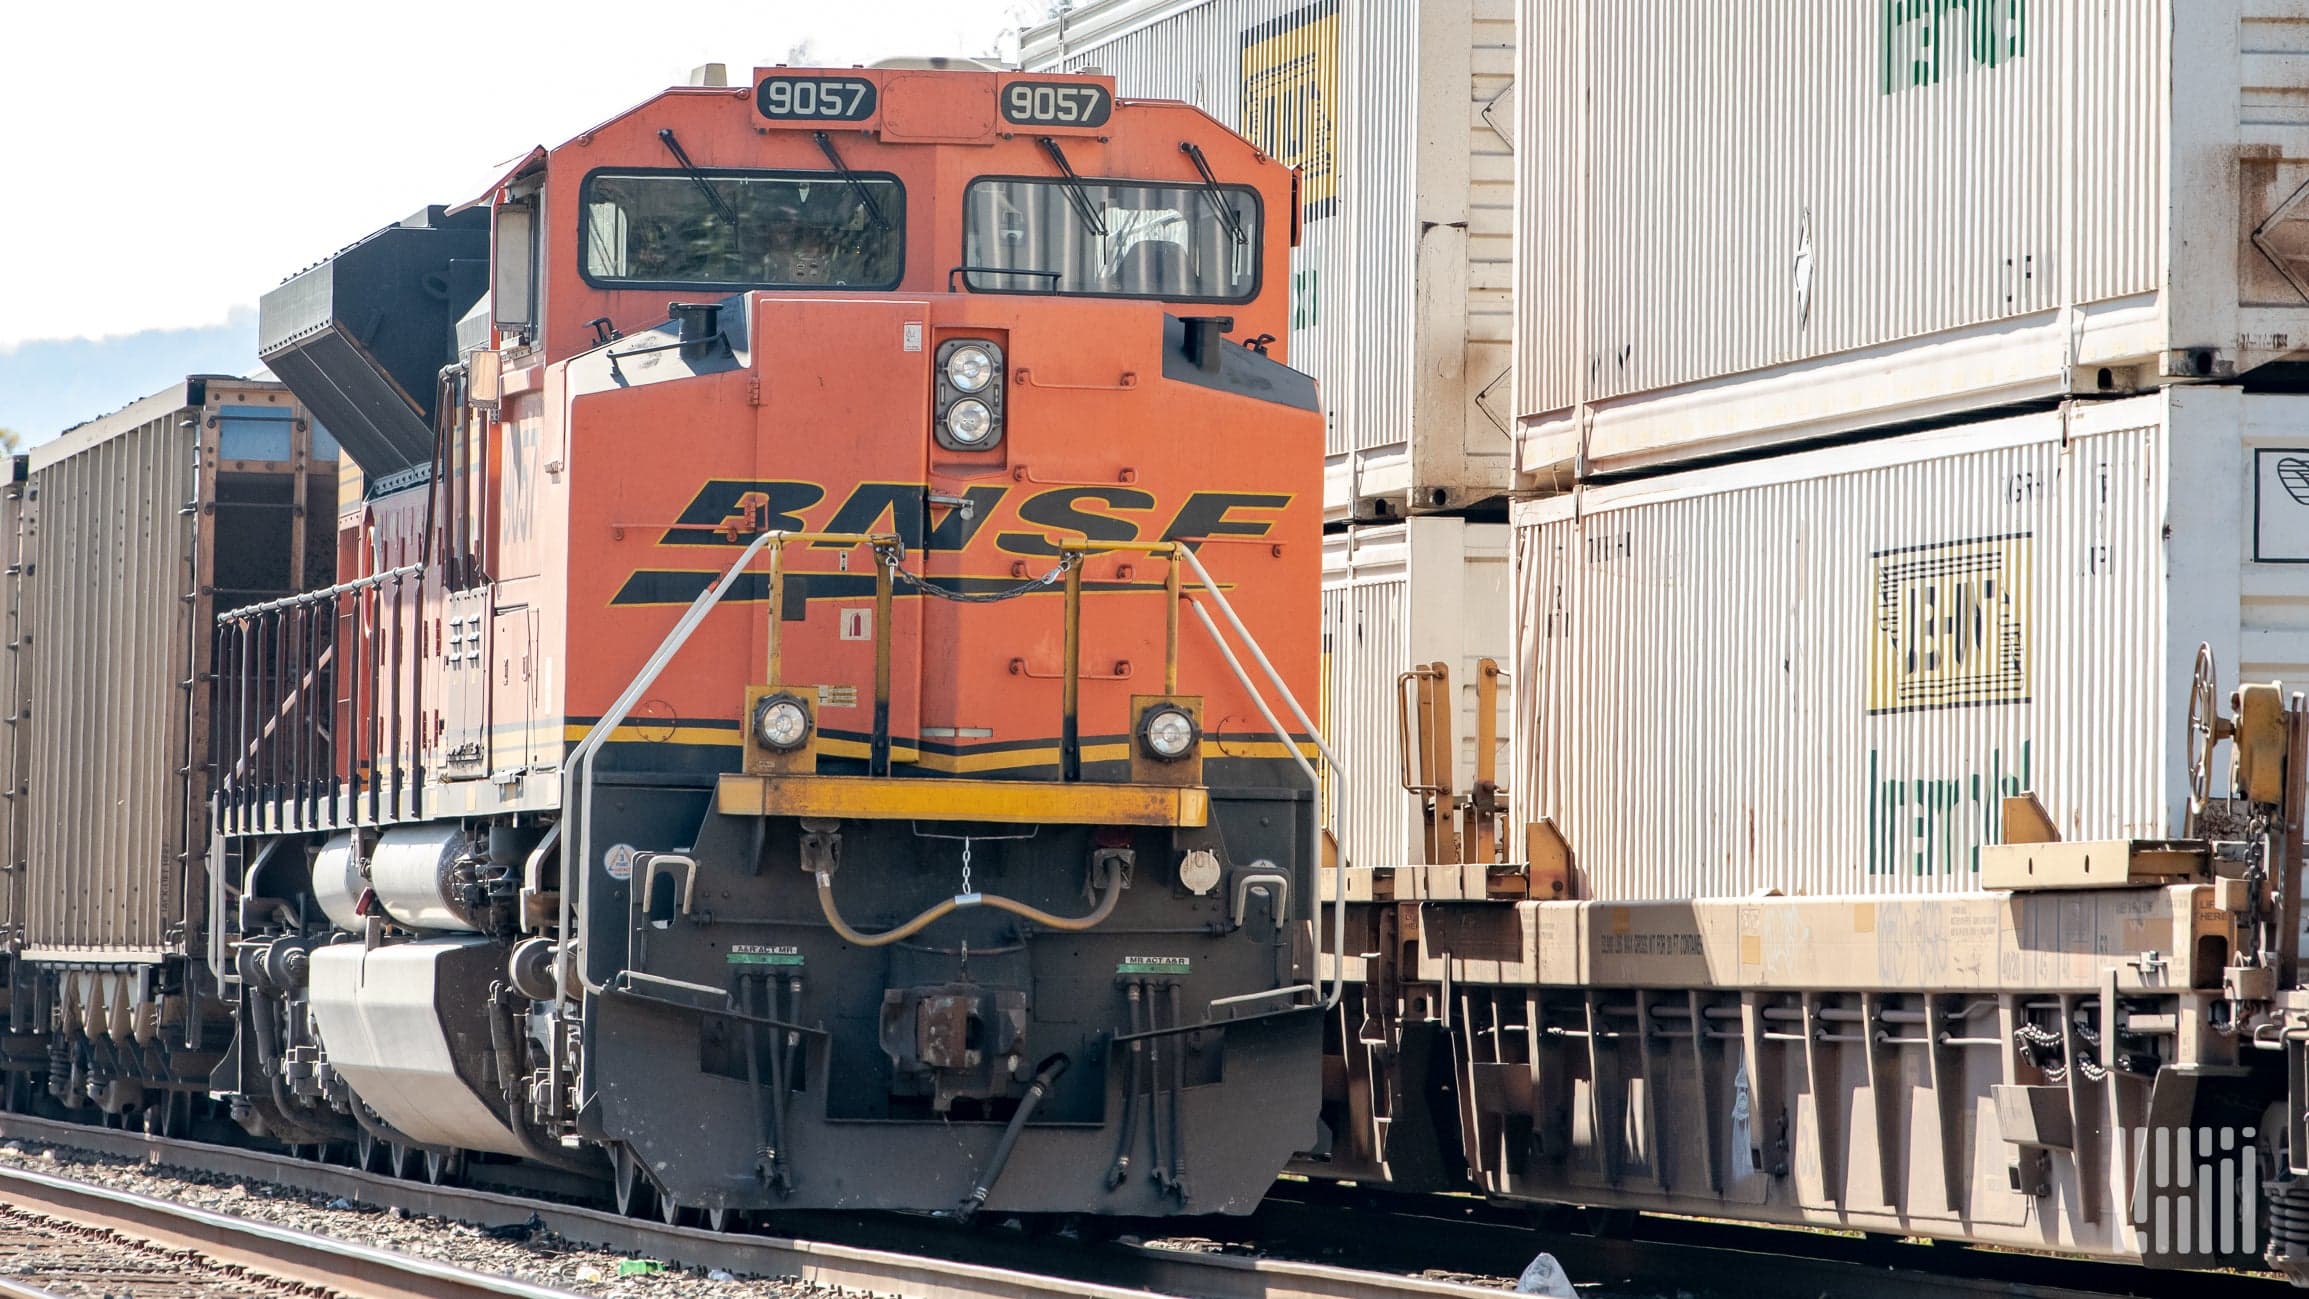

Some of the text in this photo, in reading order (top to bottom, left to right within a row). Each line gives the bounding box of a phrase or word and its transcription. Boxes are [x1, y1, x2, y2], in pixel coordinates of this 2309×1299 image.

[768, 81, 867, 116] 9057
[1010, 86, 1100, 122] 9057
[653, 479, 1299, 560] BNSF
